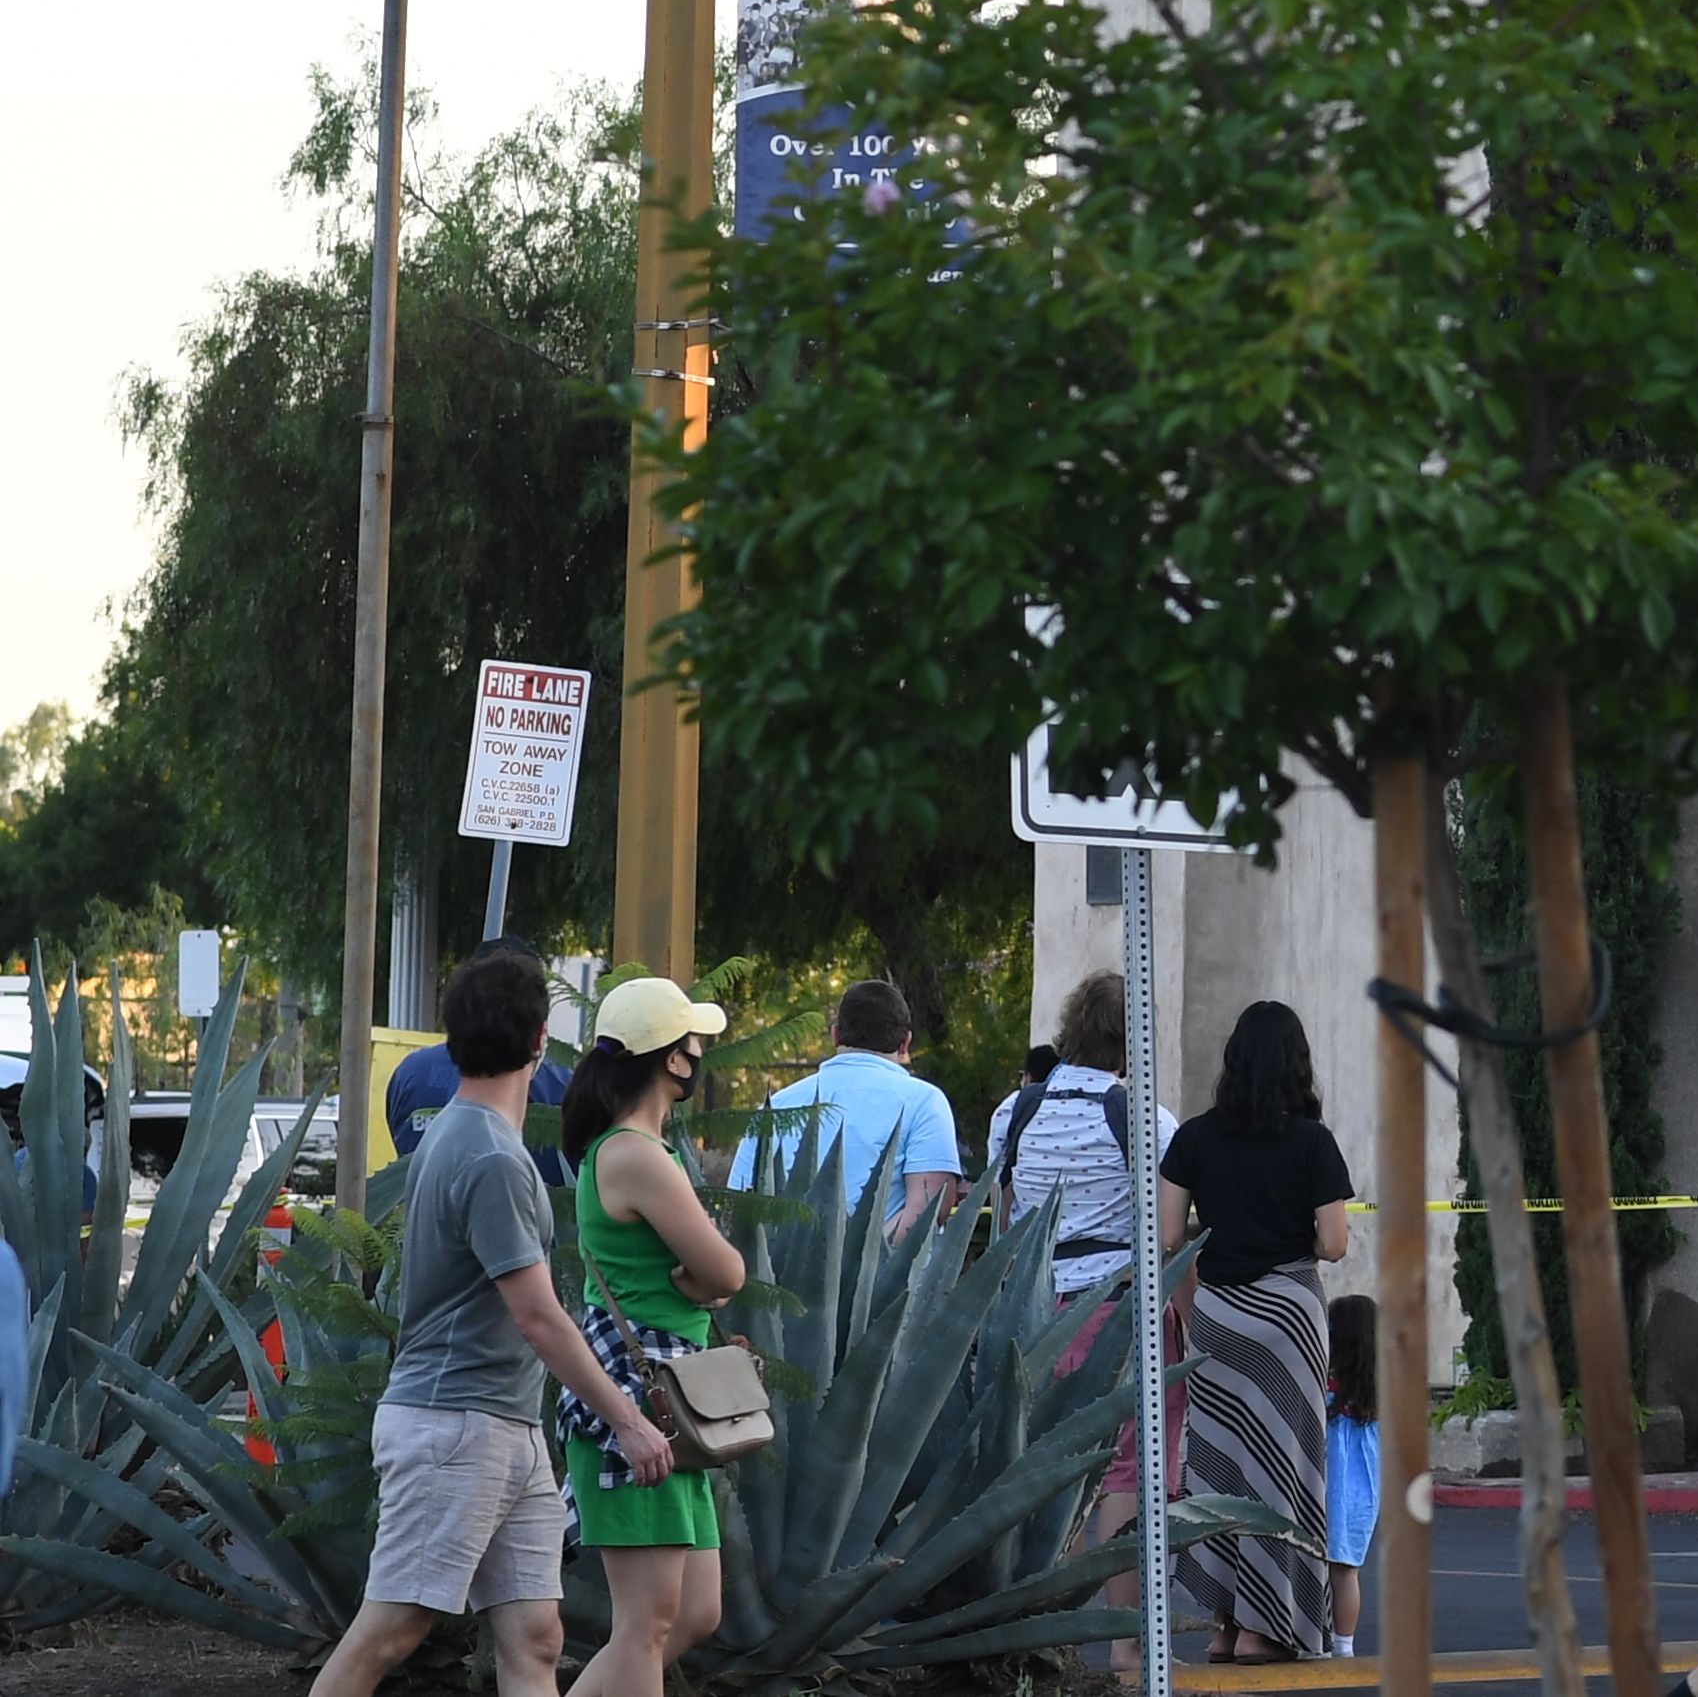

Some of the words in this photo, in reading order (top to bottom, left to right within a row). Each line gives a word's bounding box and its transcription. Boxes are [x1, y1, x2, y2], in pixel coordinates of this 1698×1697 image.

[832, 168, 860, 189] In
[487, 671, 526, 698] FIRE
[531, 675, 581, 704] LANE
[485, 705, 505, 728] NO
[509, 708, 572, 736] PARKING
[483, 740, 517, 756] TOW
[523, 745, 567, 761] AWAY
[499, 761, 544, 778] ZONE
[545, 784, 560, 796] (a)
[515, 793, 555, 806] 22500.1
[474, 813, 500, 826] (626)
[477, 804, 495, 815] SAN
[498, 806, 535, 819] GABRIEL
